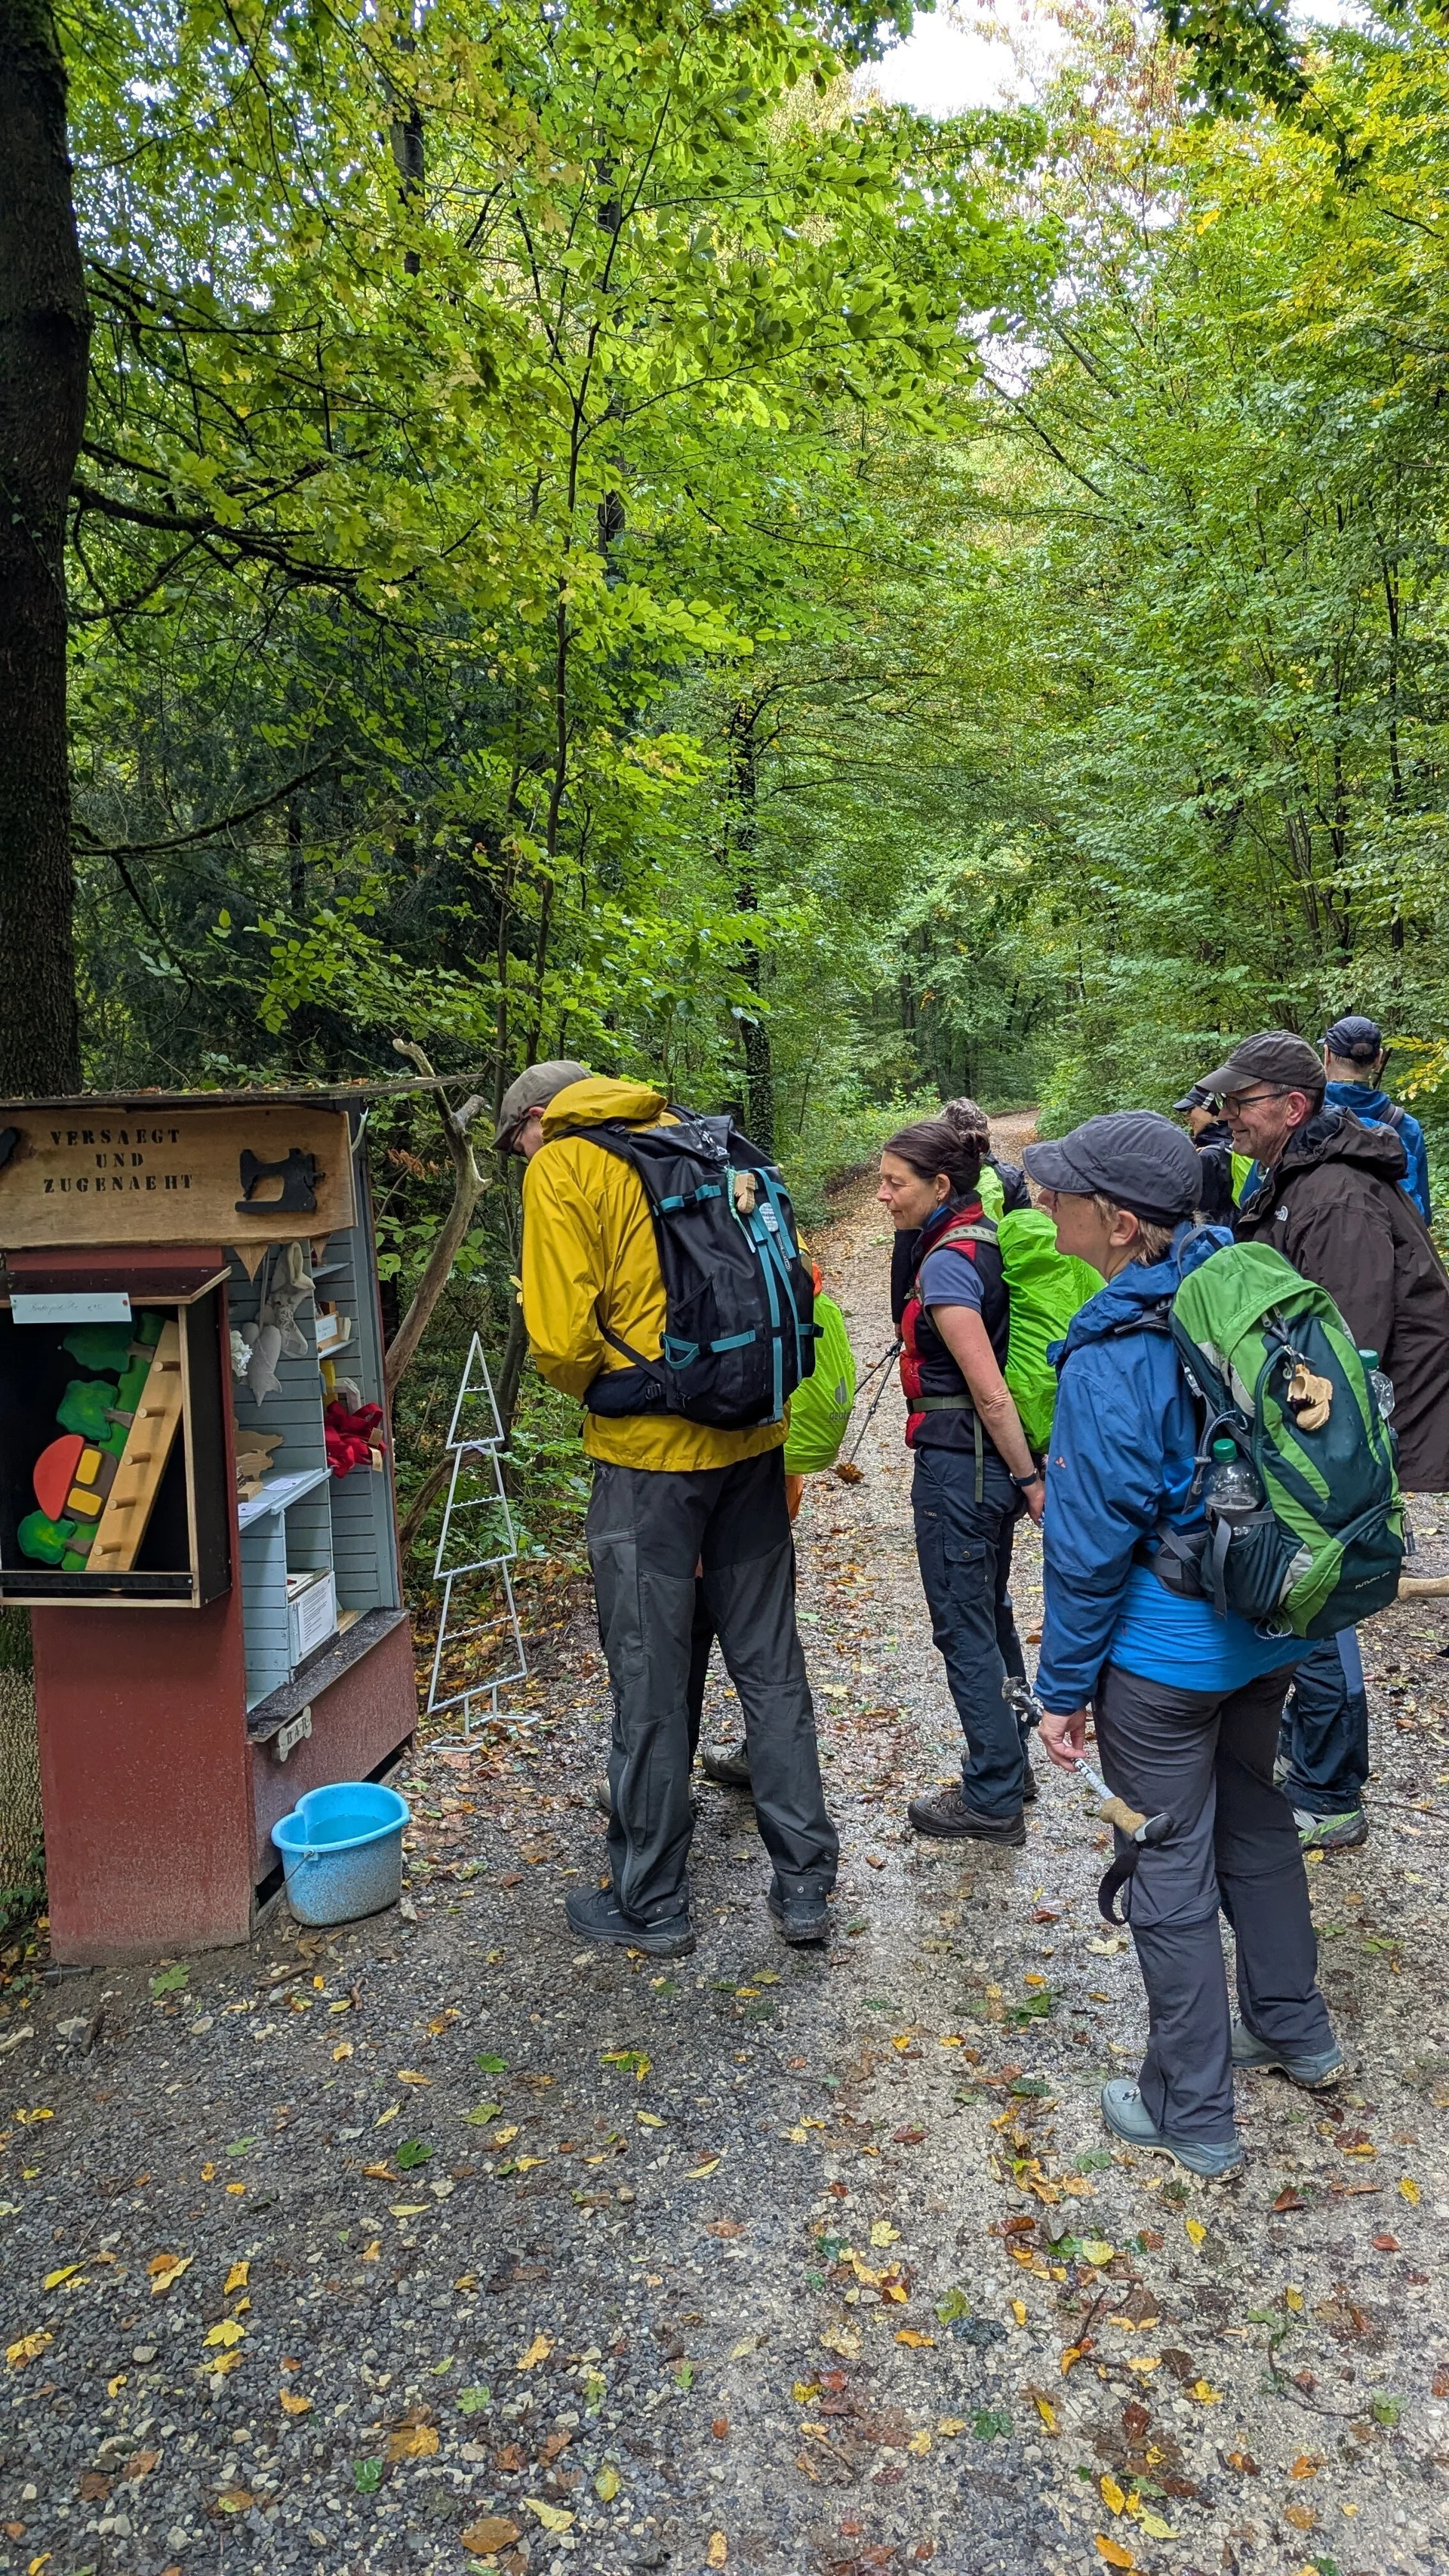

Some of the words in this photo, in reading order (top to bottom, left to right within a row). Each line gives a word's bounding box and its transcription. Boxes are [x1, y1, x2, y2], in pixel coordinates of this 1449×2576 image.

[51, 1128, 180, 1146] VERSAEGT
[96, 1153, 144, 1168] UND
[44, 1174, 192, 1193] ZUGENAEHT
[287, 1717, 310, 1745] BAR
